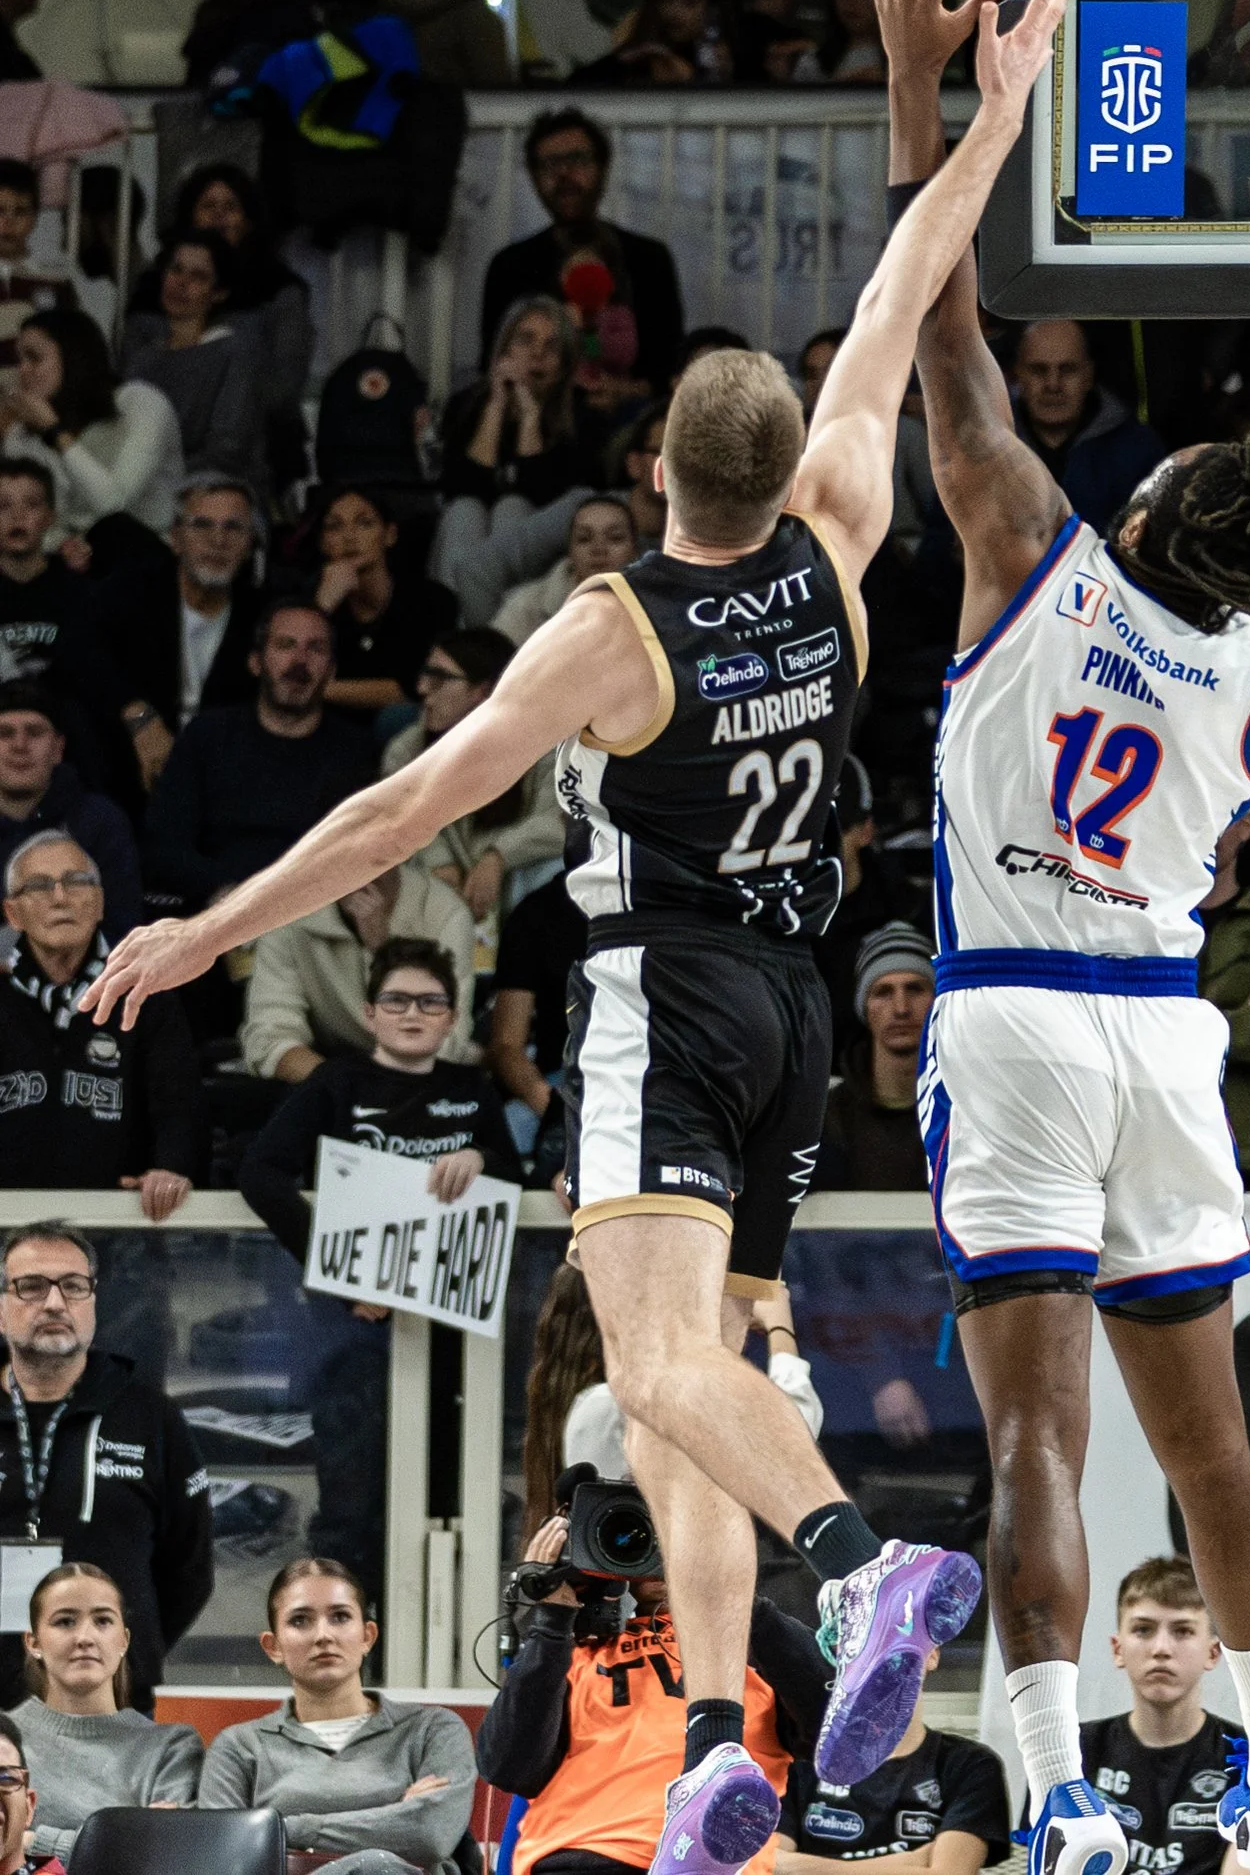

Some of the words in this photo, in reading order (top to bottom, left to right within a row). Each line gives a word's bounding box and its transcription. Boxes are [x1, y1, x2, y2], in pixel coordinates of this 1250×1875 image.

[1088, 143, 1174, 174] FIP
[687, 567, 813, 628] CAVIT
[734, 618, 794, 642] TRENTO
[1107, 600, 1221, 693] Volksbank
[701, 660, 766, 692] Melinda
[785, 641, 836, 670] TRENTINO
[710, 675, 834, 745] ALDRIDGE
[717, 737, 825, 875] 22
[1046, 705, 1164, 871] 12
[682, 1166, 711, 1189] BTS
[318, 1228, 364, 1286] WE
[376, 1214, 428, 1299] DIE
[432, 1199, 509, 1323] HARD
[1096, 1766, 1131, 1796] BC
